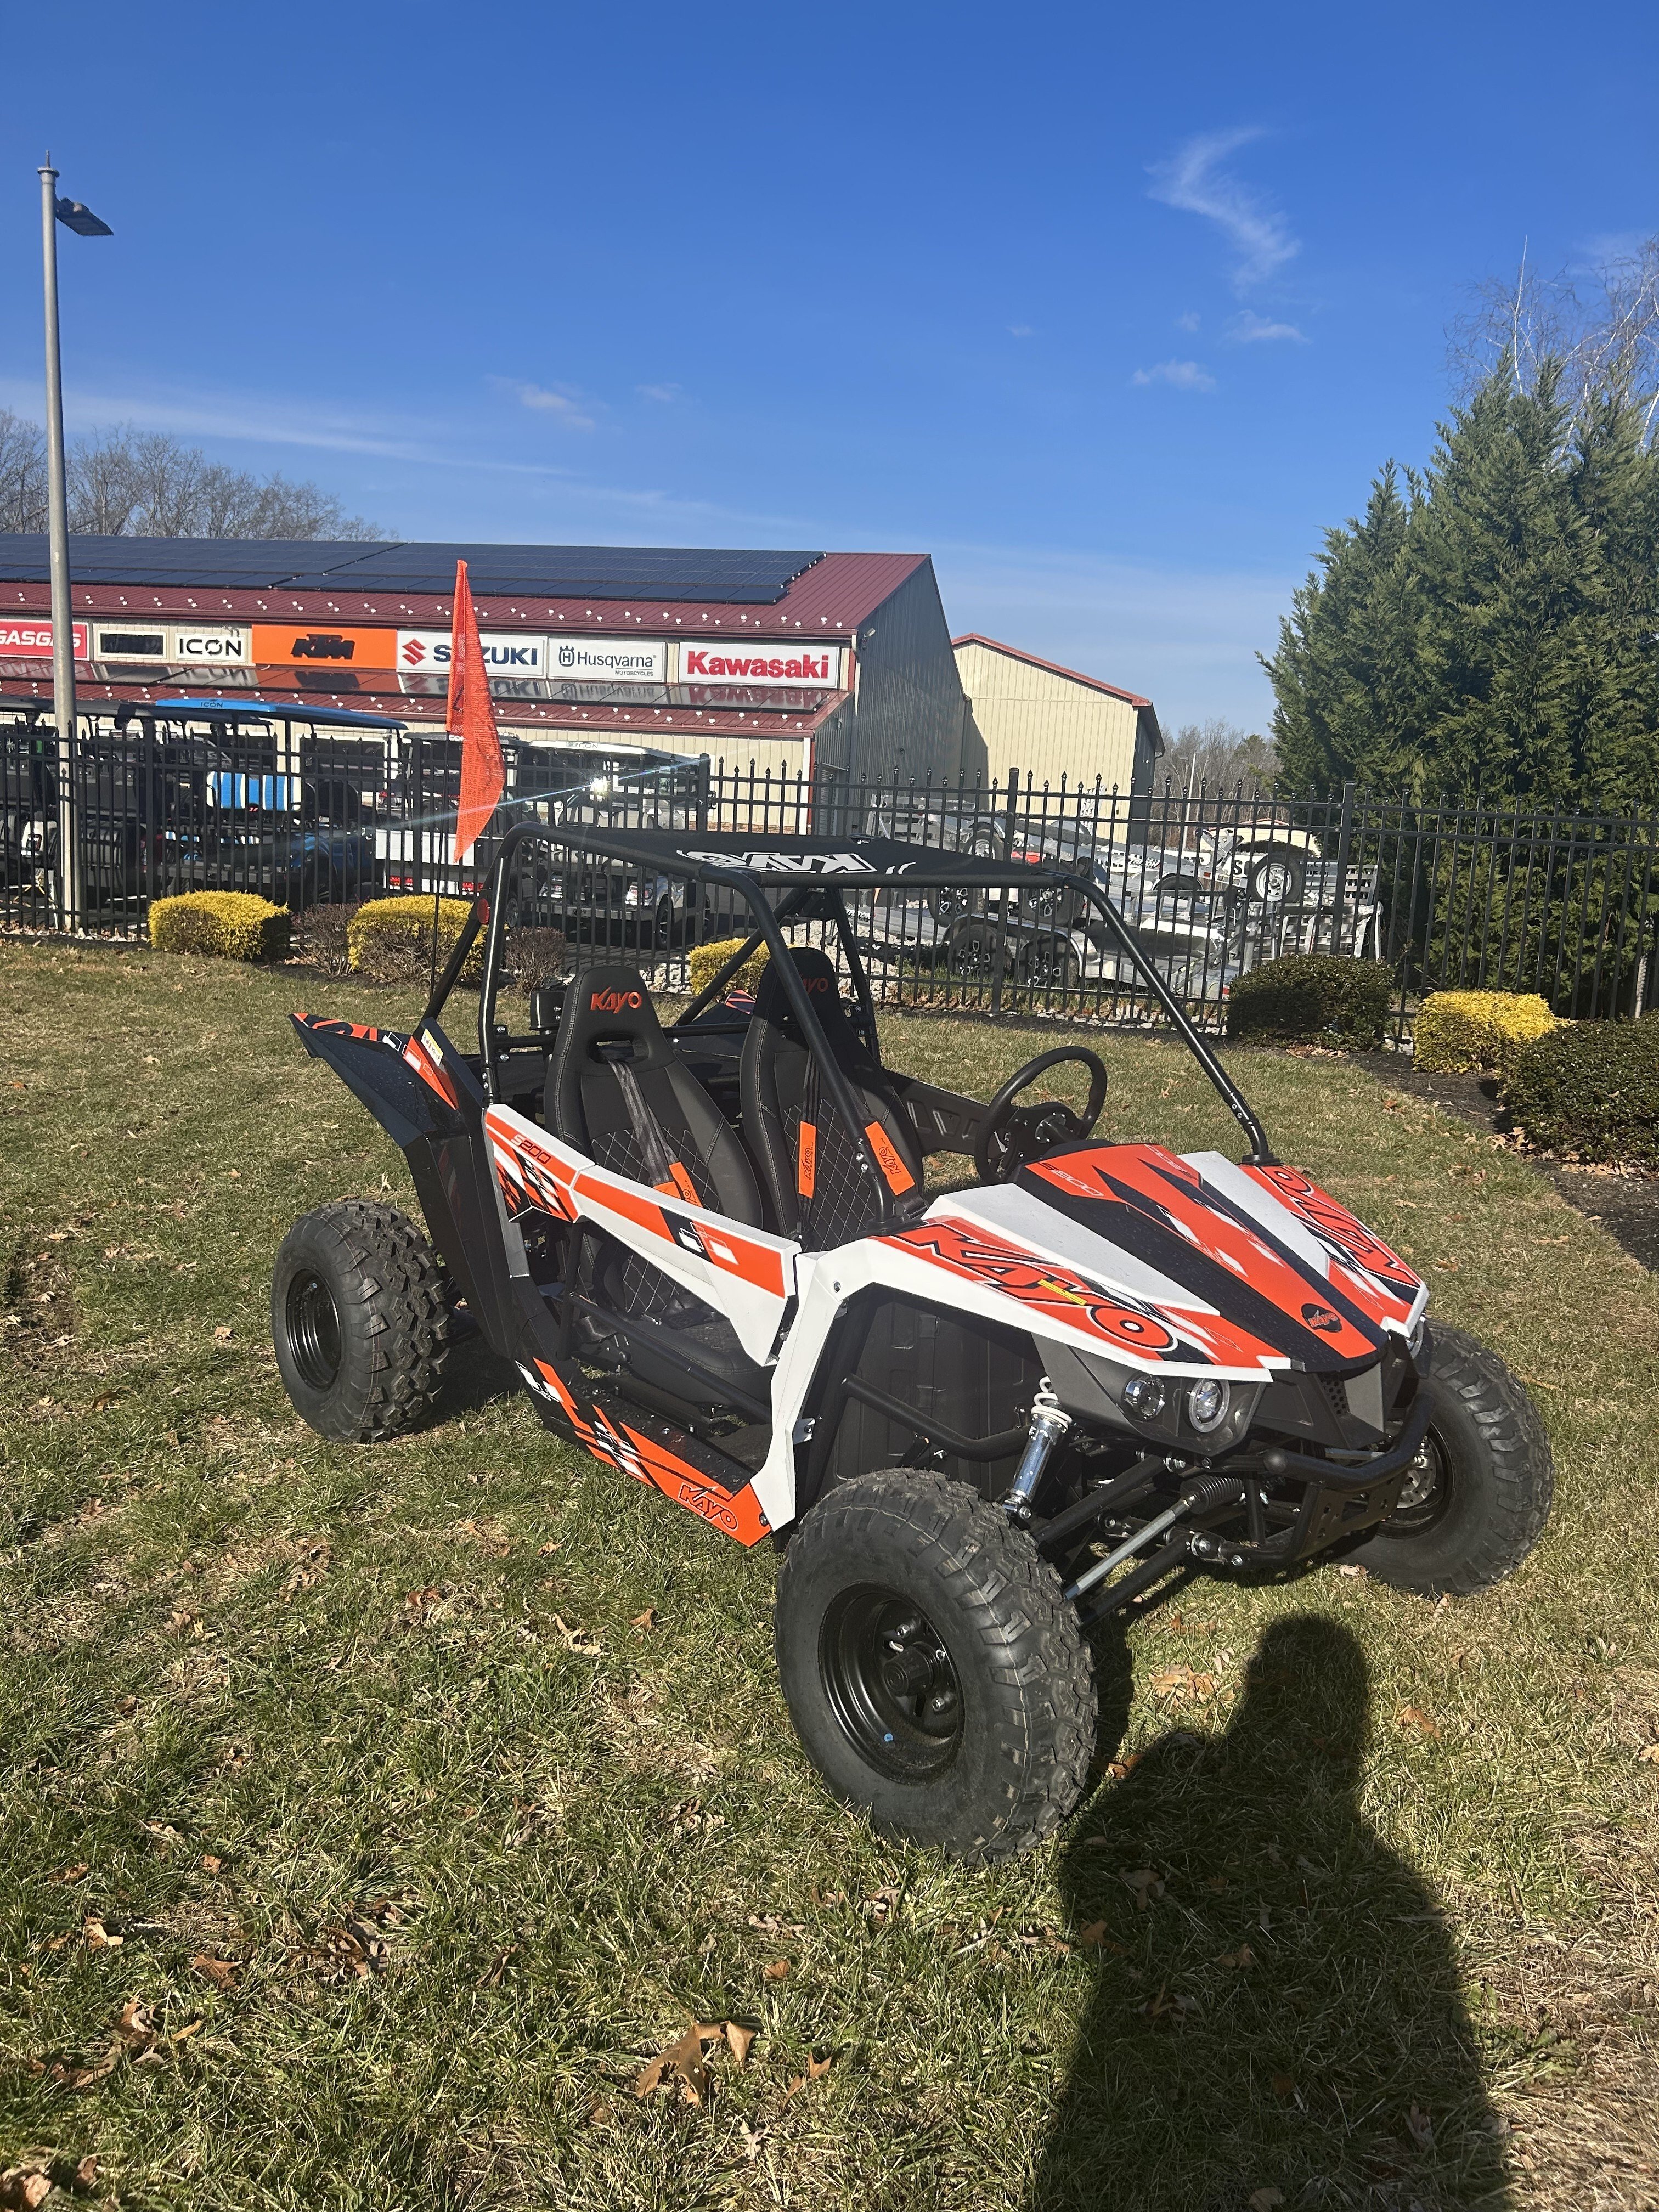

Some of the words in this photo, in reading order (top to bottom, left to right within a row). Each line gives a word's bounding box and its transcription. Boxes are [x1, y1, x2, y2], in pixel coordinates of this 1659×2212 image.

[0, 630, 81, 648] ASGS
[179, 638, 241, 656] ICON
[291, 634, 355, 660] KTM
[433, 644, 537, 665] SUKI
[578, 651, 653, 668] Husqvarna
[687, 651, 829, 679] Kawasaki
[590, 986, 642, 1014] KAYO
[511, 1133, 551, 1164] S200
[879, 1147, 901, 1175] KAYO
[800, 1147, 812, 1180] KAYO
[1038, 1161, 1104, 1197] S200
[678, 1482, 738, 1532] KAYO
